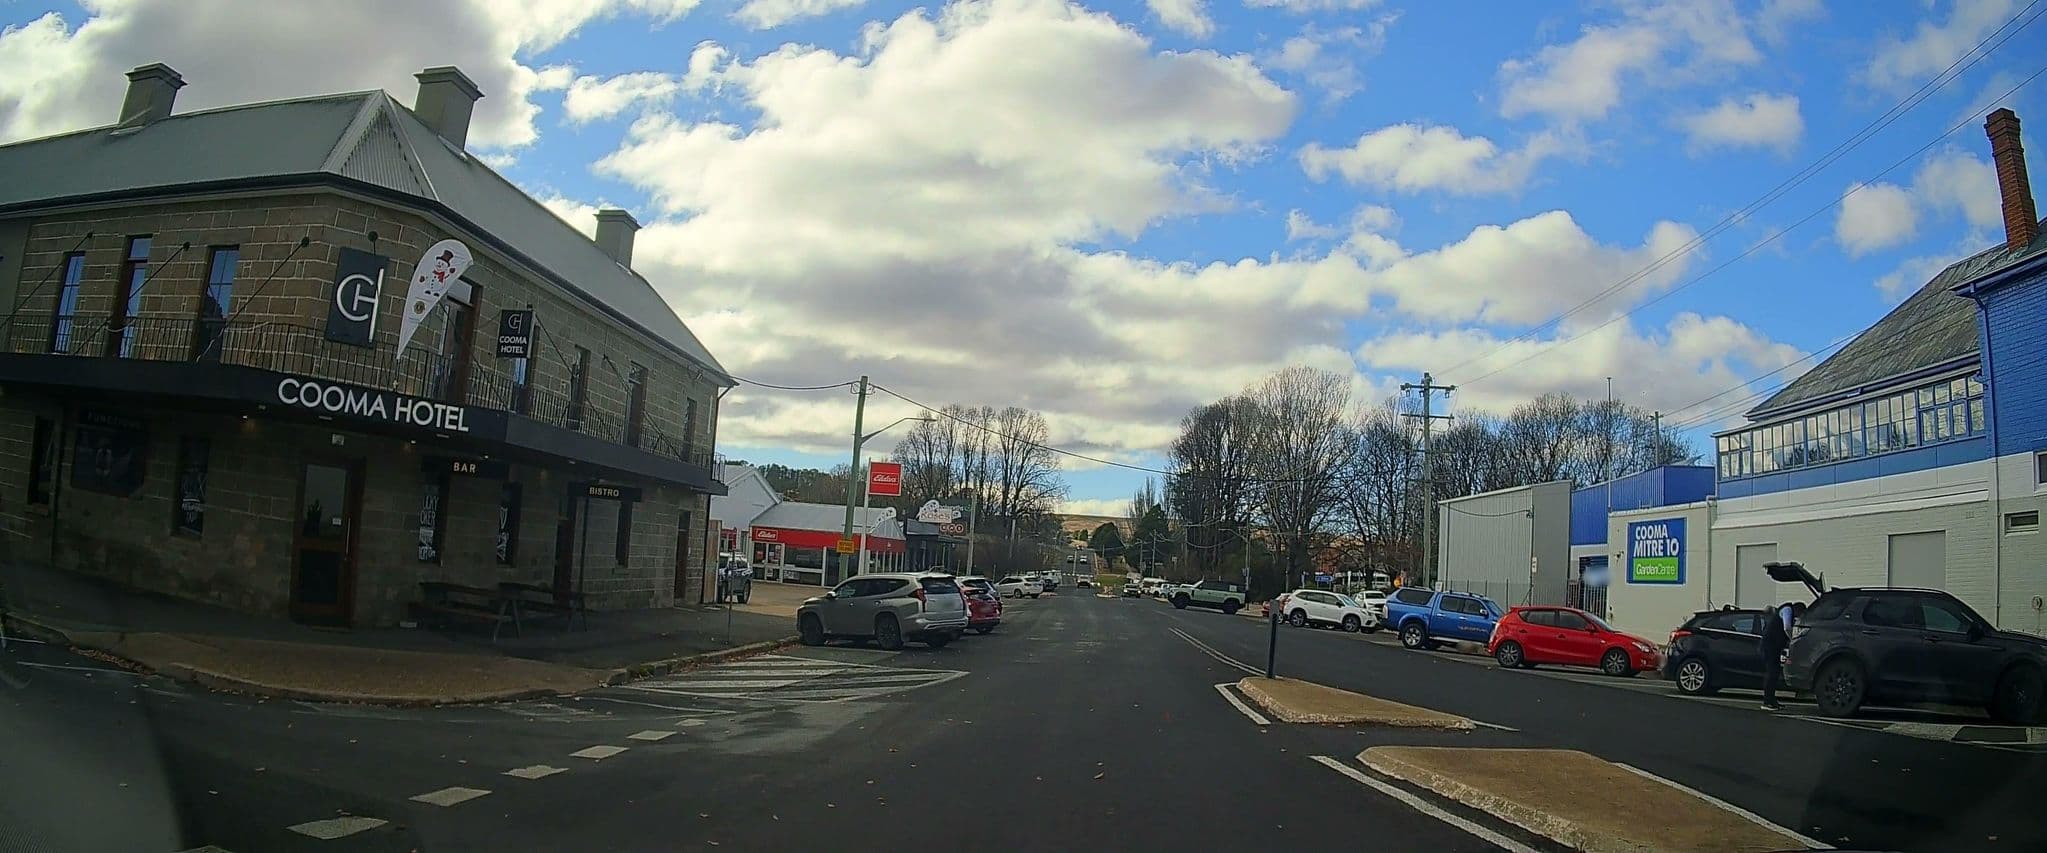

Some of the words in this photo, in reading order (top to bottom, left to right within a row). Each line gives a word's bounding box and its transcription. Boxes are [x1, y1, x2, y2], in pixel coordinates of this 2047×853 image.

[499, 335, 527, 345] COOMA
[500, 345, 525, 354] HOTEL
[278, 378, 388, 420] COOMA
[394, 397, 469, 432] HOTEL
[453, 461, 477, 474] BAR
[589, 486, 620, 497] BISTRO
[1636, 525, 1668, 539] COOMA
[1634, 540, 1663, 557] MITRE
[1667, 538, 1679, 556] 10
